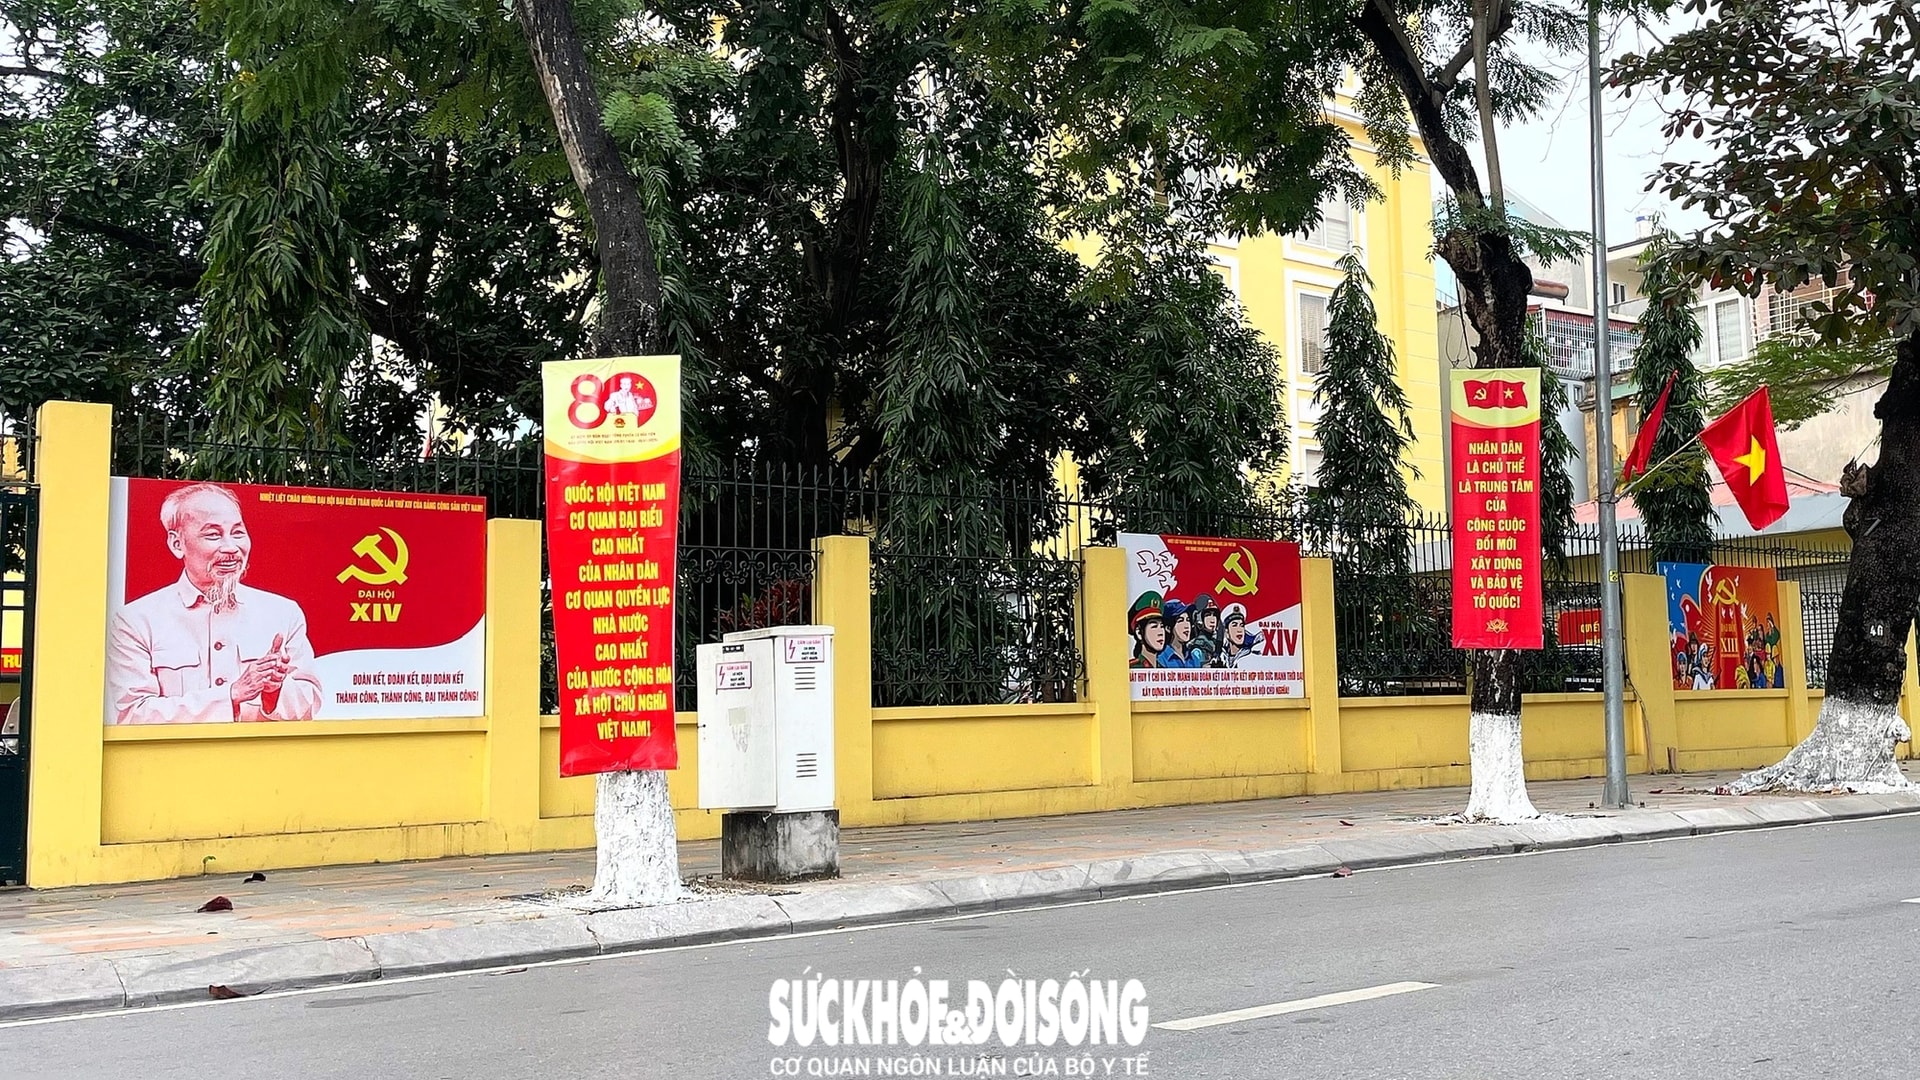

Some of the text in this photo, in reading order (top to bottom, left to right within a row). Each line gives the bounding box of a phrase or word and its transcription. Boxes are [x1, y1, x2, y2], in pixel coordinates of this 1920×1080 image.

[1469, 440, 1523, 454] NHÂN DÂN
[1467, 457, 1525, 473] LÀ CHỦ THỂ
[565, 480, 666, 506] QUỐC HỘI VIỆT NAM
[1459, 478, 1533, 493] LÀ TRUNG TÂM
[1486, 496, 1506, 511] CỦA
[570, 503, 663, 532] CƠ QUAN ĐẠI BIỂU
[1467, 517, 1526, 534] CÔNG CUỘC
[592, 532, 644, 555] CAO NHẤT
[1476, 534, 1516, 550] ĐỔI MỚI
[579, 559, 658, 582] CỦA NHÂN DÂN
[1471, 555, 1522, 572] XÂY DỰNG
[1471, 573, 1523, 592] VÀ BẢO VỆ
[358, 589, 395, 600] ĐẠI HỘI
[566, 584, 670, 610] CƠ QUAN QUYỀN LỰC
[1473, 592, 1520, 610] TỔ QUỐC!
[350, 603, 402, 622] XIV
[593, 612, 648, 634] NHÀ NƯỚC
[596, 635, 648, 661] CAO NHẤT
[1262, 629, 1298, 656] XIV
[1720, 638, 1738, 652] XIII
[353, 671, 464, 687] ĐOÀN KẾT, ĐOÀN KẾT, ĐẠI ĐOÀN KẾT
[567, 662, 672, 690] CỦA NƯỚC CỘNG HÒA
[336, 689, 479, 704] THÀNH CÔNG, THÀNH CÔNG, ĐẠI THÀNH CÔNG!
[575, 689, 667, 717] XÃ HỘI CHỦ NGHĨA
[597, 718, 651, 742] VIỆT NAM!
